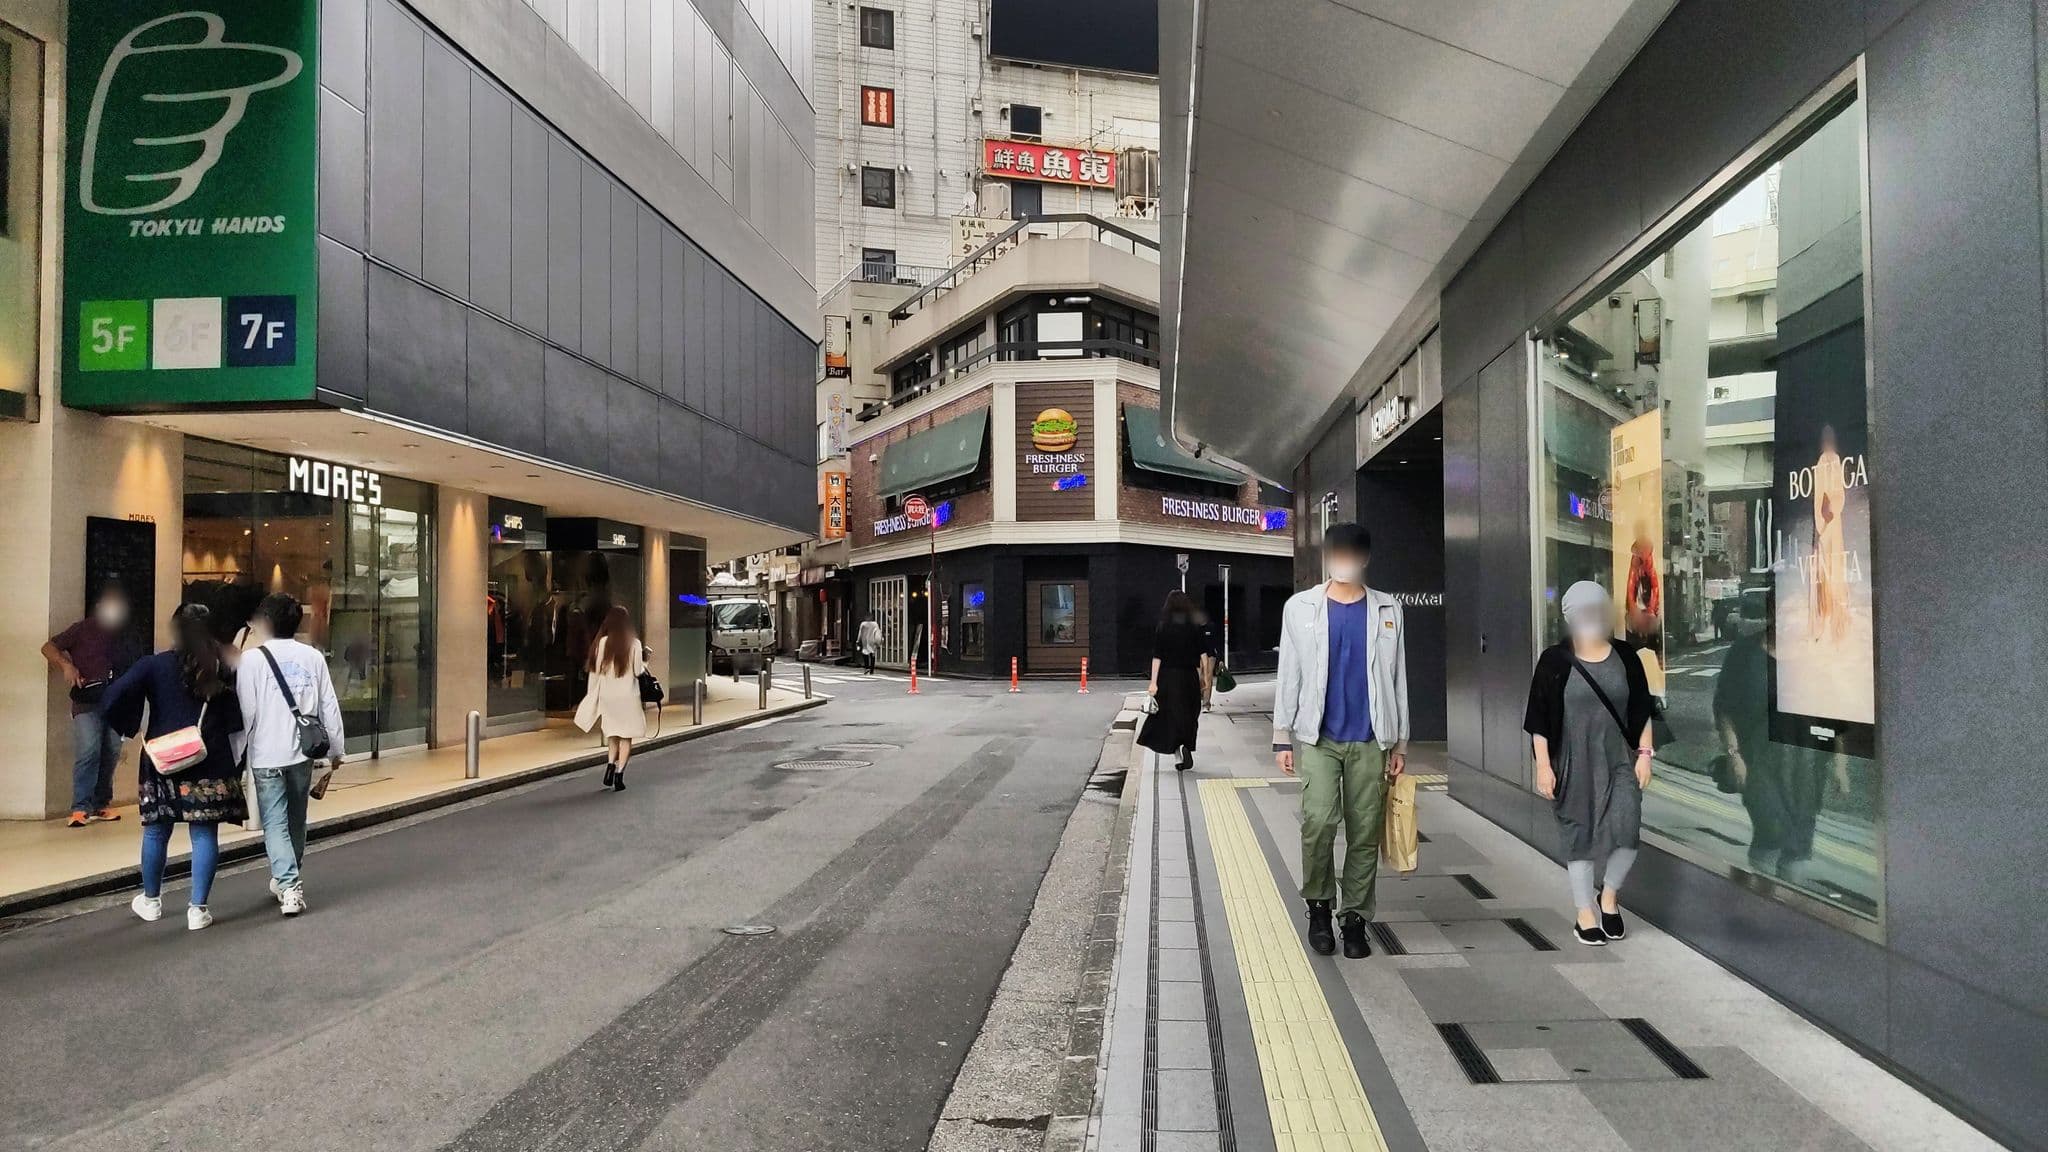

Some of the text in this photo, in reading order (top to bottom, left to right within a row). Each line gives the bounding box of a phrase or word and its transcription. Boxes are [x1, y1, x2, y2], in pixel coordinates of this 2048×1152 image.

[992, 148, 1036, 173] 鮮魚
[129, 215, 285, 238] TOKYU HANDS
[91, 317, 136, 353] 5F
[163, 314, 210, 352] 6F
[240, 313, 285, 350] 7F
[828, 366, 844, 376] Bar
[1025, 453, 1085, 464] FRESHNESS
[1033, 463, 1078, 474] BURGER
[289, 457, 381, 506] MORE'S
[504, 514, 523, 530] SHIPS
[830, 496, 841, 527] 大黒屋
[1162, 497, 1219, 521] FRESHNESS
[1222, 505, 1261, 526] BURGER
